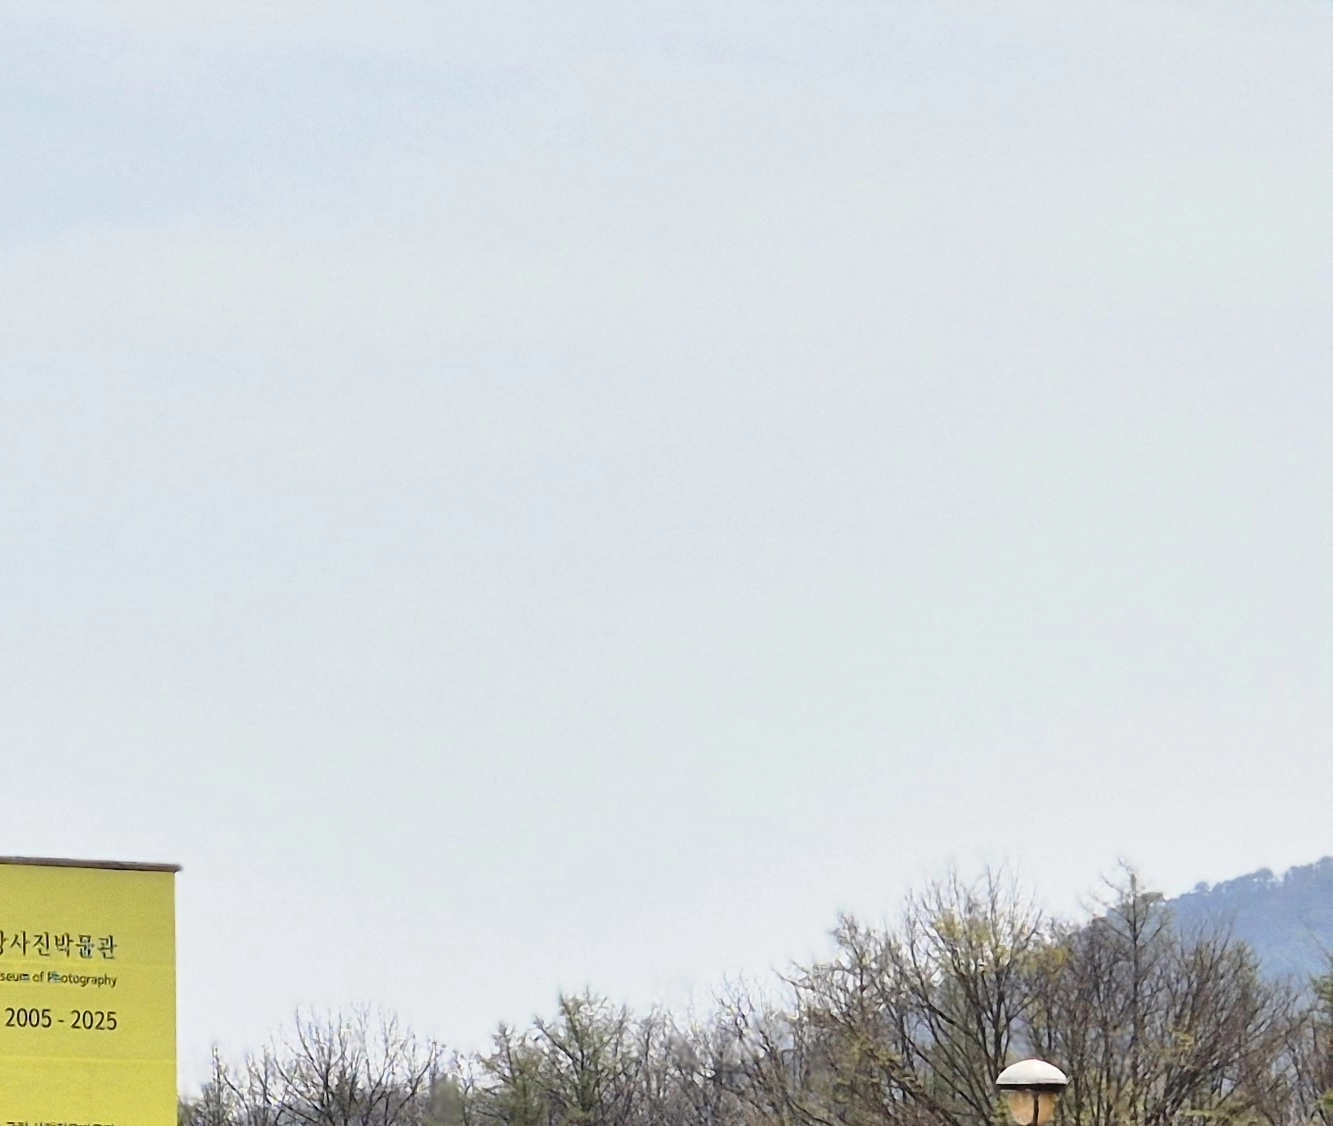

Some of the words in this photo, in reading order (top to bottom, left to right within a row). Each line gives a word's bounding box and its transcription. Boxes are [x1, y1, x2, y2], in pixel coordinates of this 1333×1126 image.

[32, 971, 45, 982] of
[47, 971, 118, 988] Photography
[4, 1007, 52, 1028] 2005
[70, 1009, 118, 1031] 2025
